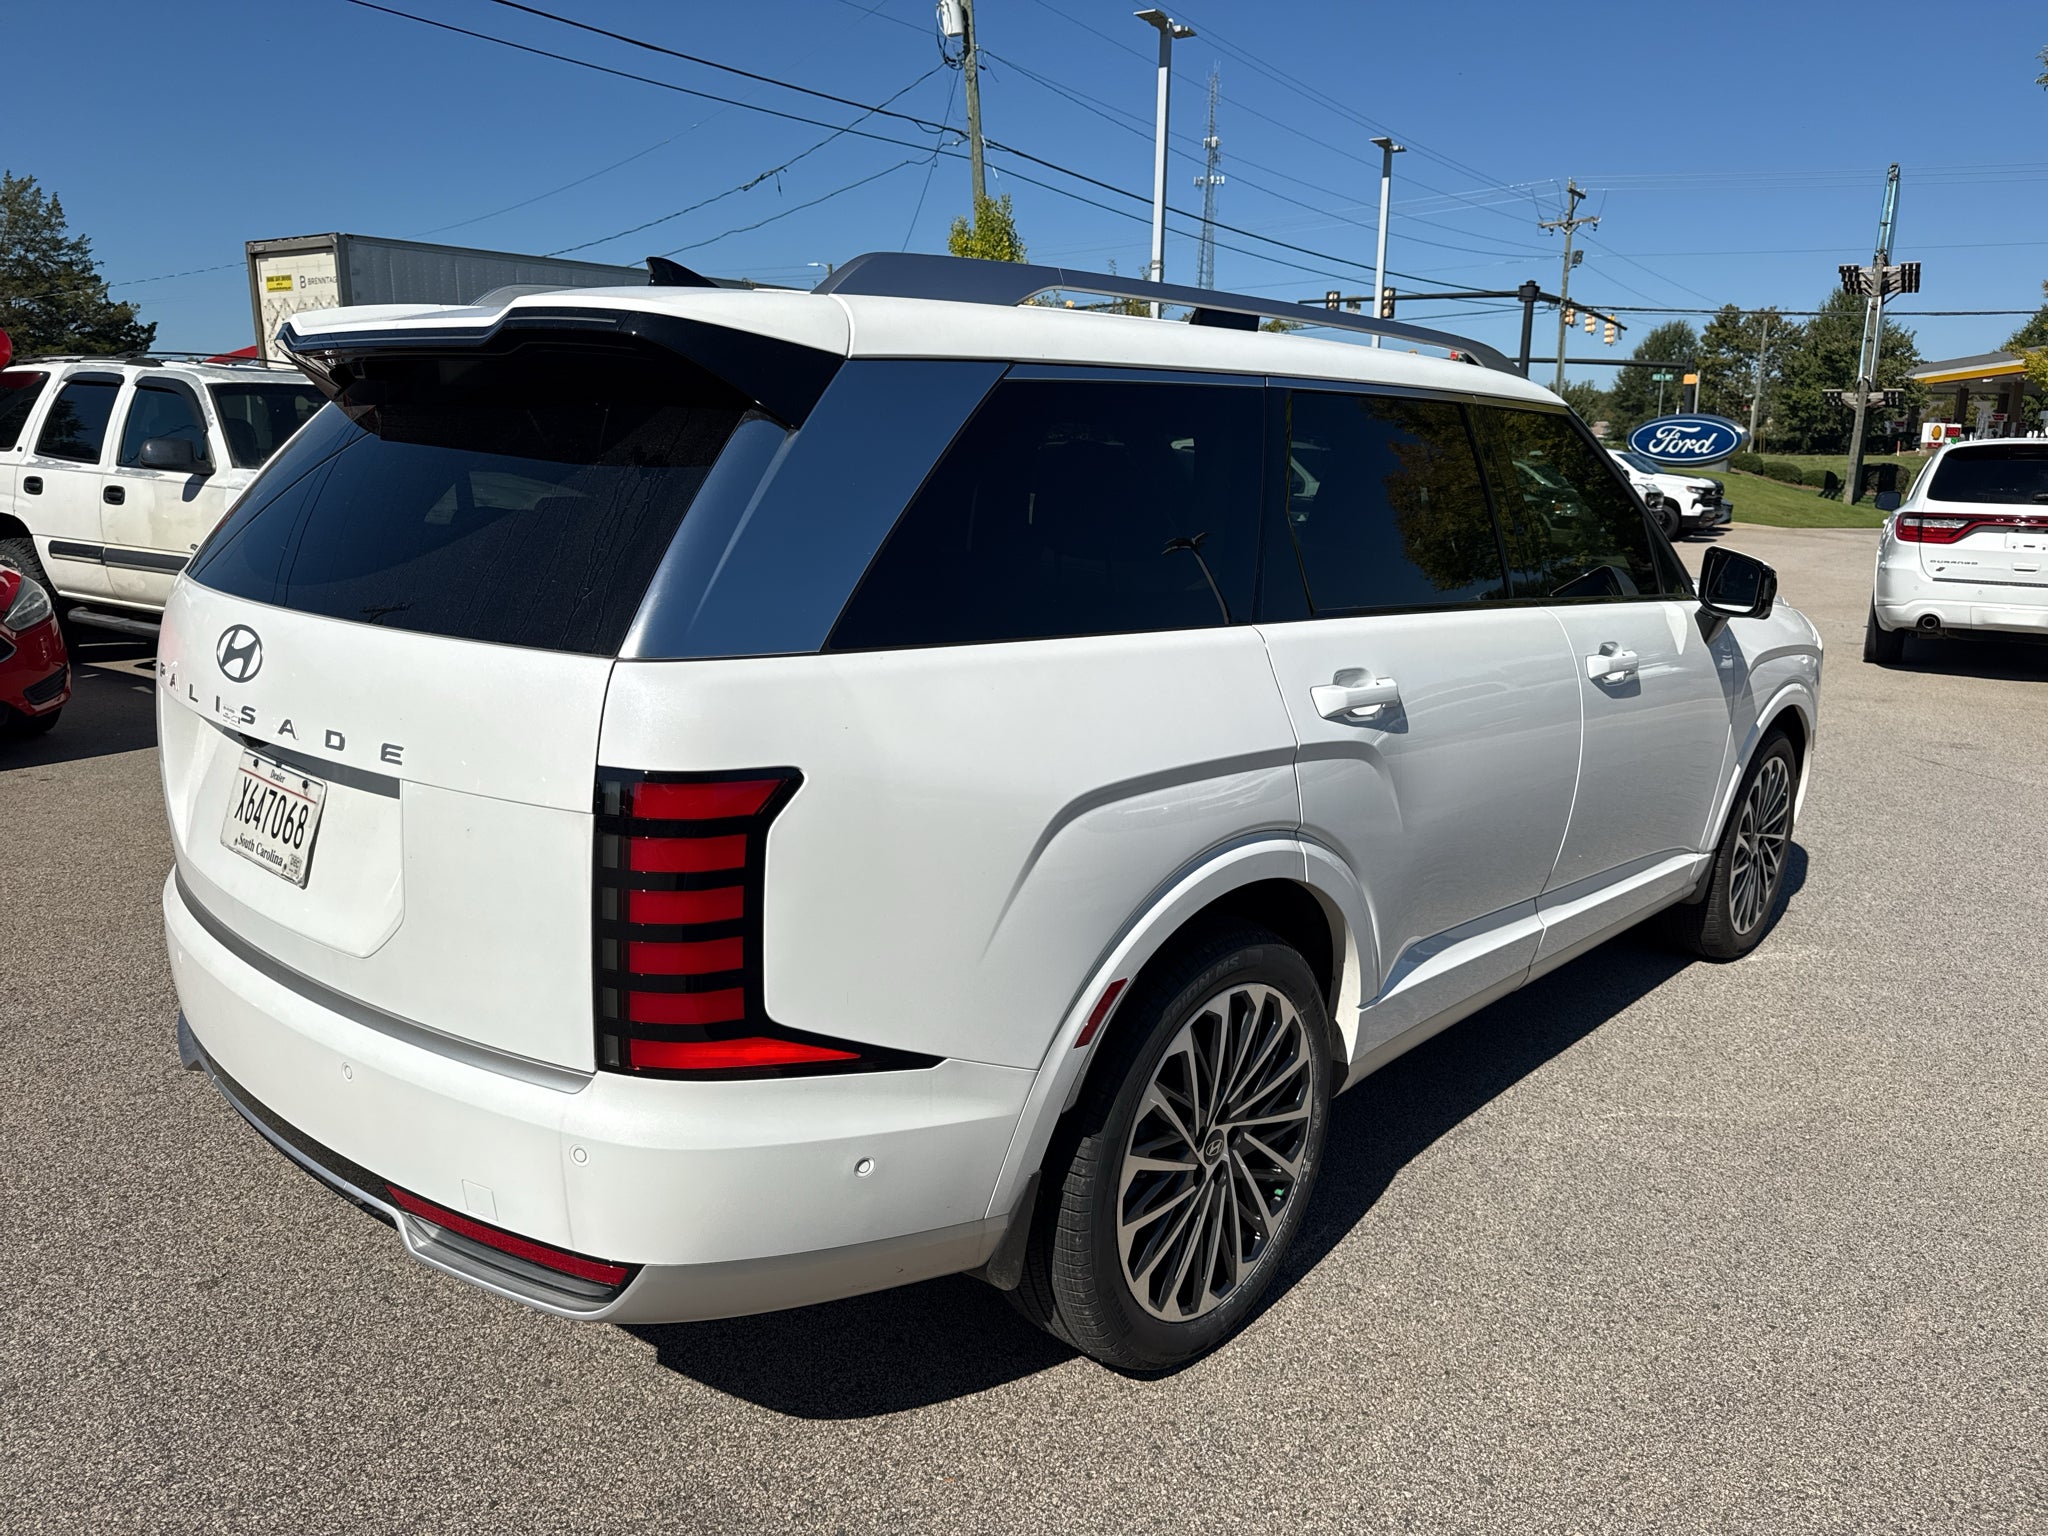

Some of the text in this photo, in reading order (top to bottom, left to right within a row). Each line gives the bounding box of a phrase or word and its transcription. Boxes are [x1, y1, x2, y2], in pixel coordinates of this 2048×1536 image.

[1648, 425, 1718, 454] Ford
[160, 661, 404, 766] PALISADE
[269, 769, 286, 784] Dealer
[233, 775, 309, 850] X647068
[238, 832, 284, 867] South Carolina
